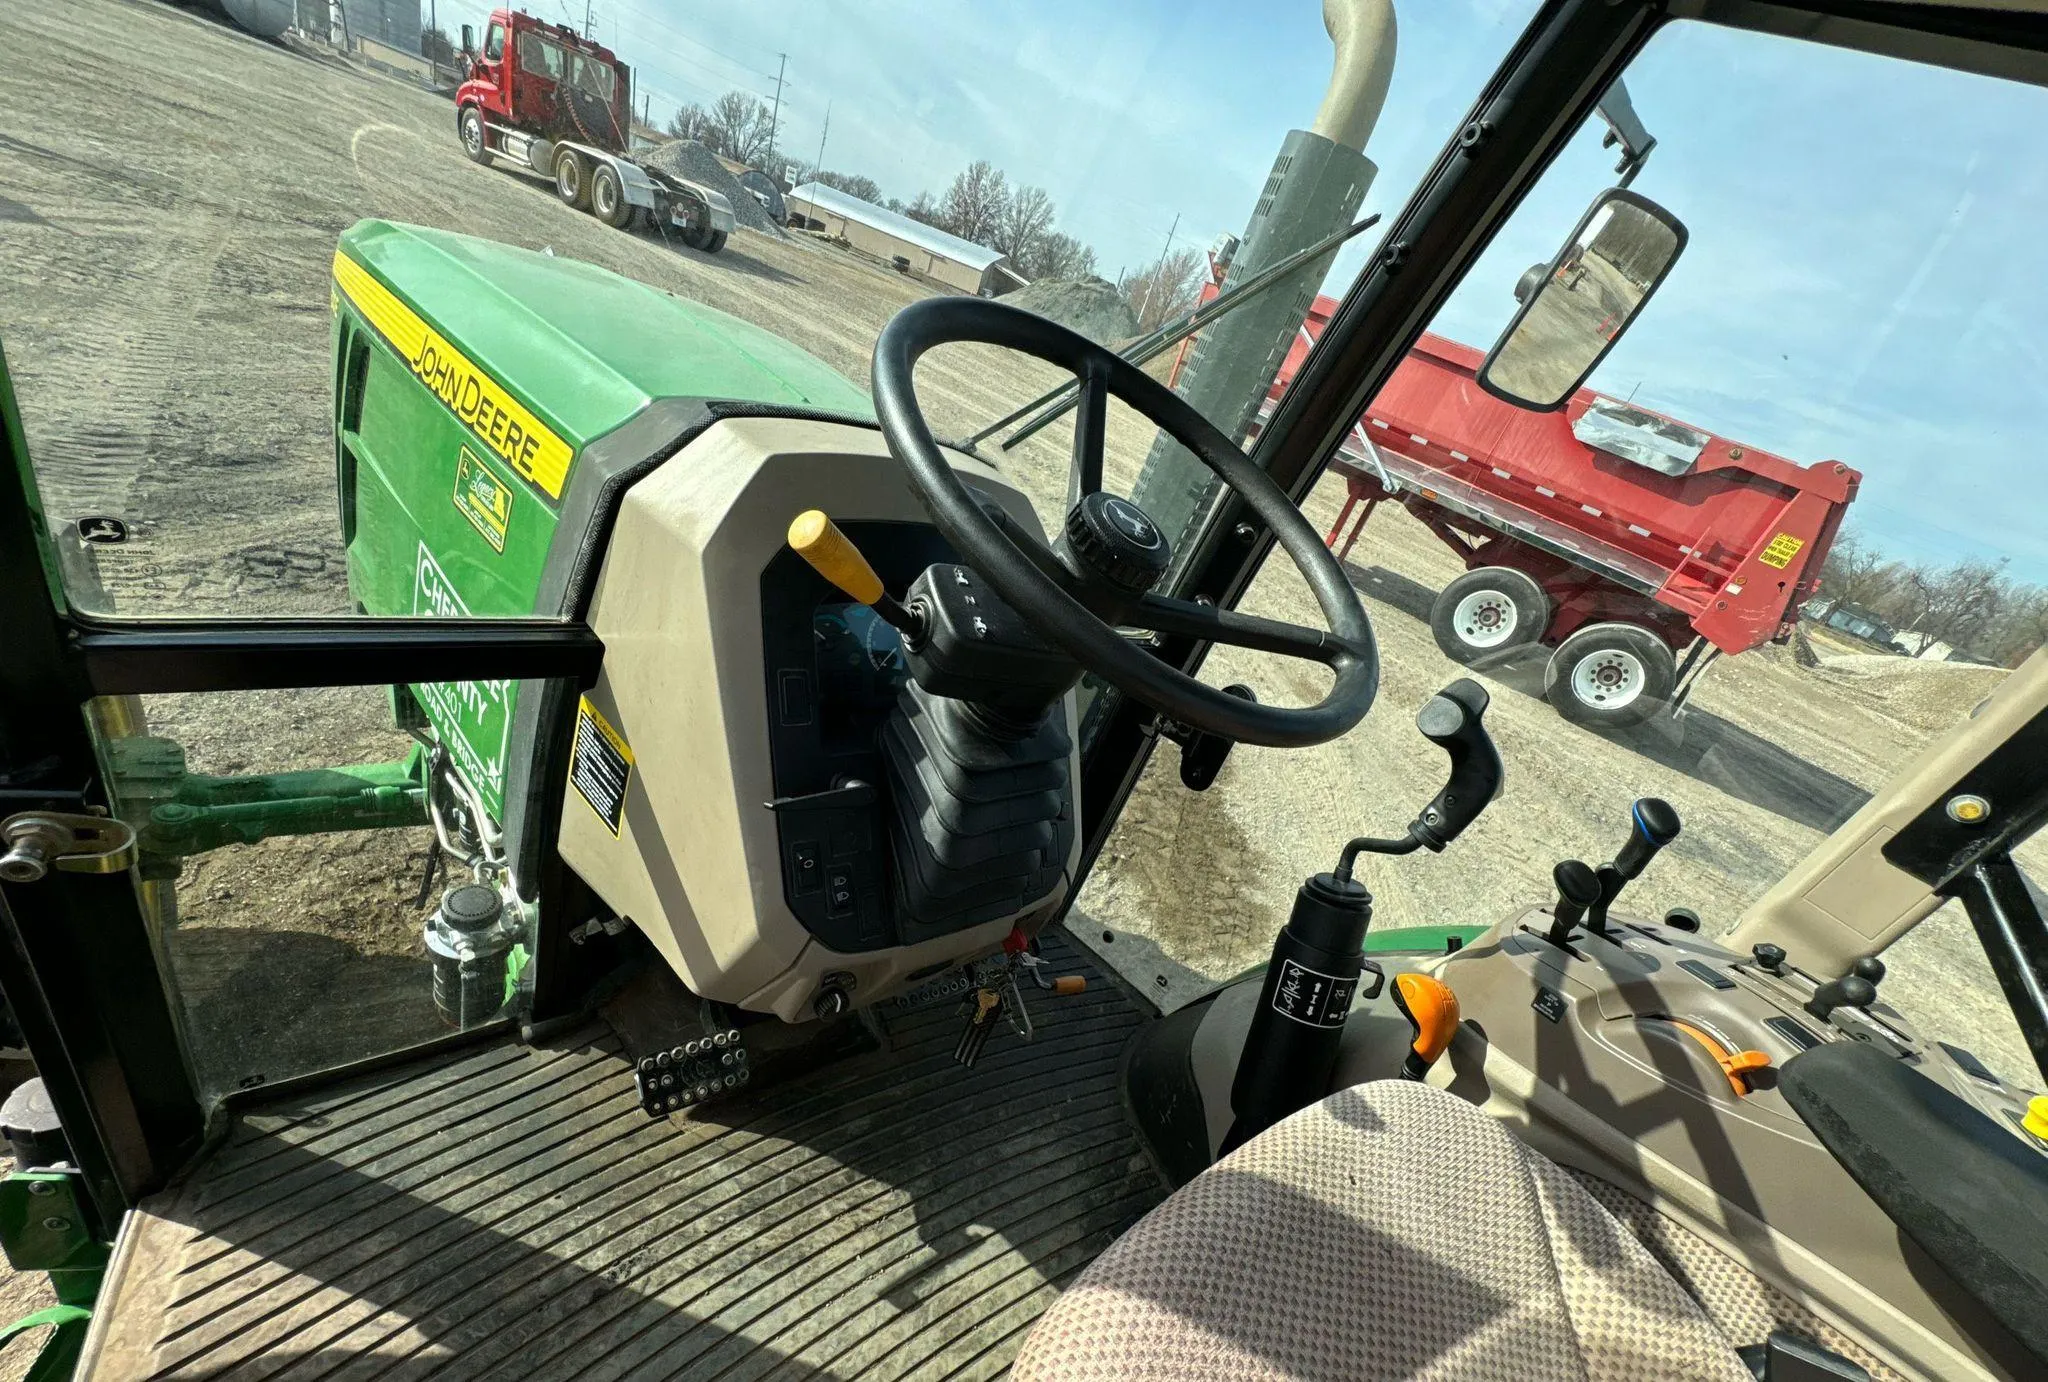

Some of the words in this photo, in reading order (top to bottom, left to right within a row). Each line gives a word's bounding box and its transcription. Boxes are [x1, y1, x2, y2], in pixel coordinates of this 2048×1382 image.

[413, 334, 463, 404] JOHN
[460, 374, 541, 475] DEERE
[451, 729, 484, 793] BRIDGE
